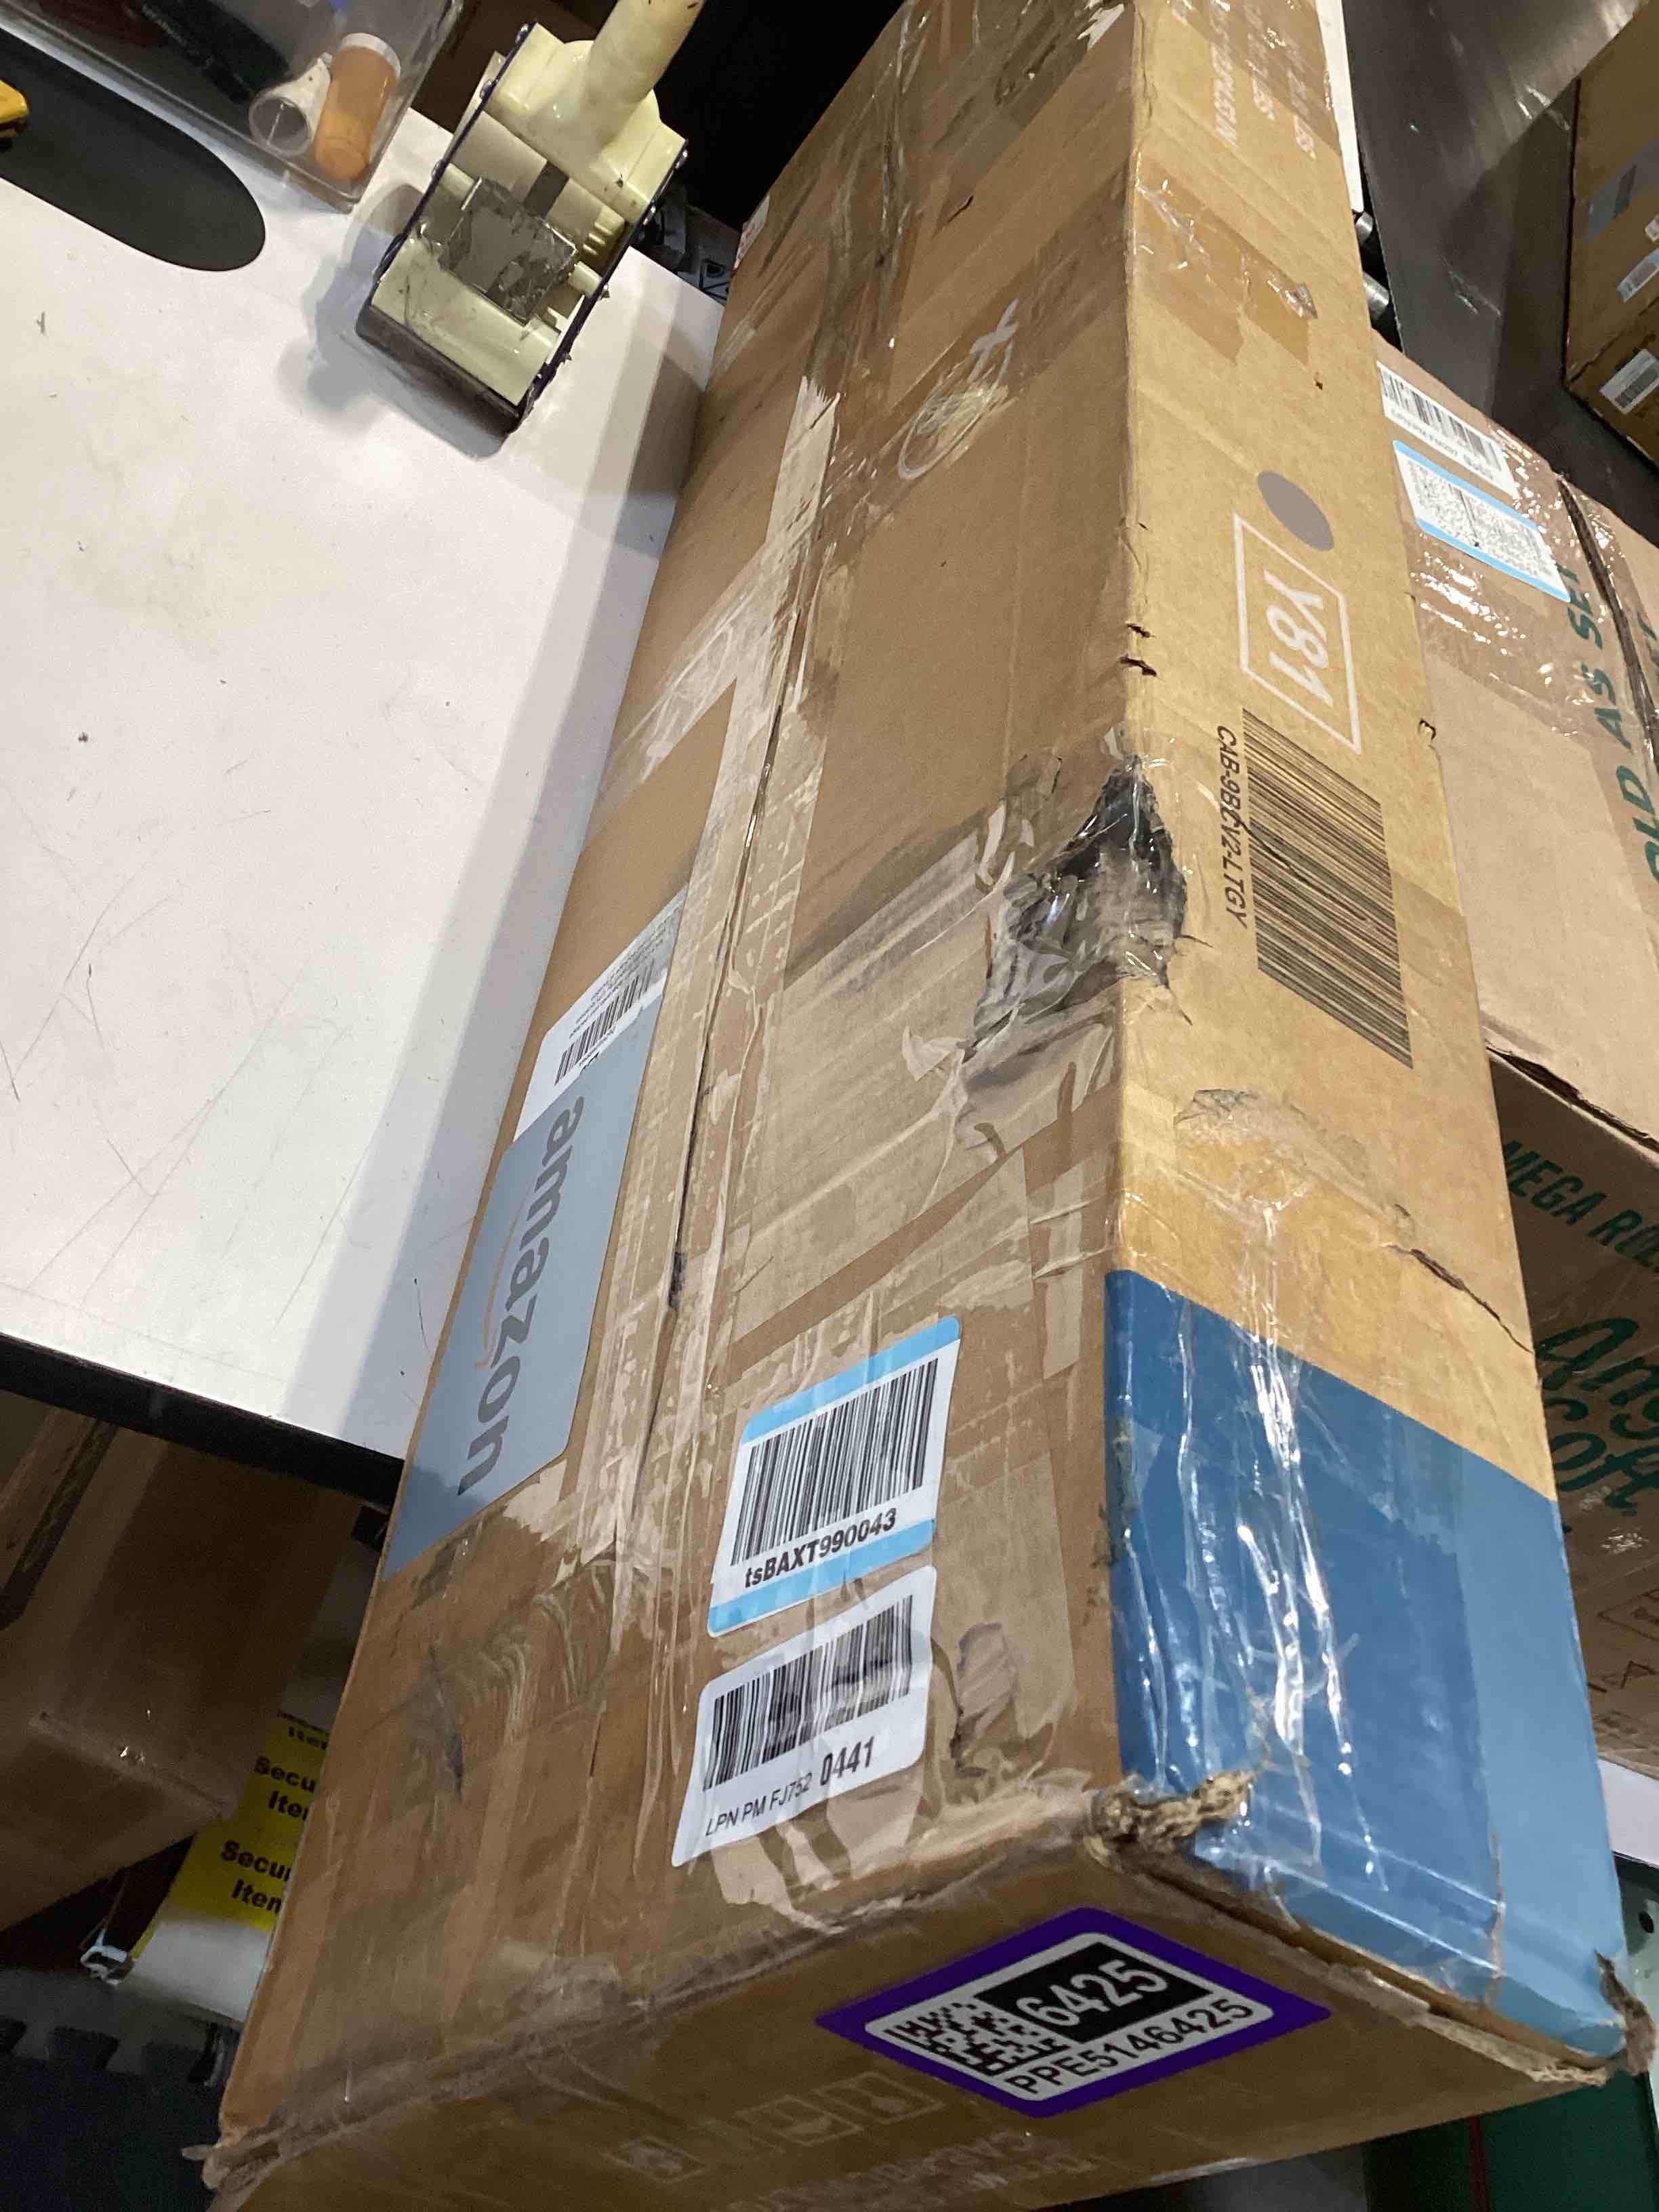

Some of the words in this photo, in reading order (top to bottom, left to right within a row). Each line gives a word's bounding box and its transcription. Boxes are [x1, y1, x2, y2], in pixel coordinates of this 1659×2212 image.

[1263, 567, 1334, 705] Y81
[1581, 661, 1633, 752] AS
[457, 1095, 584, 1496] amazon
[745, 1507, 897, 1588] tsBAXT990043
[705, 1808, 739, 1837] LPN
[741, 1796, 766, 1822] PM
[820, 1736, 875, 1786] 0441
[1016, 1959, 1168, 2026] 6425
[1005, 1999, 1254, 2095] PPE5146425
